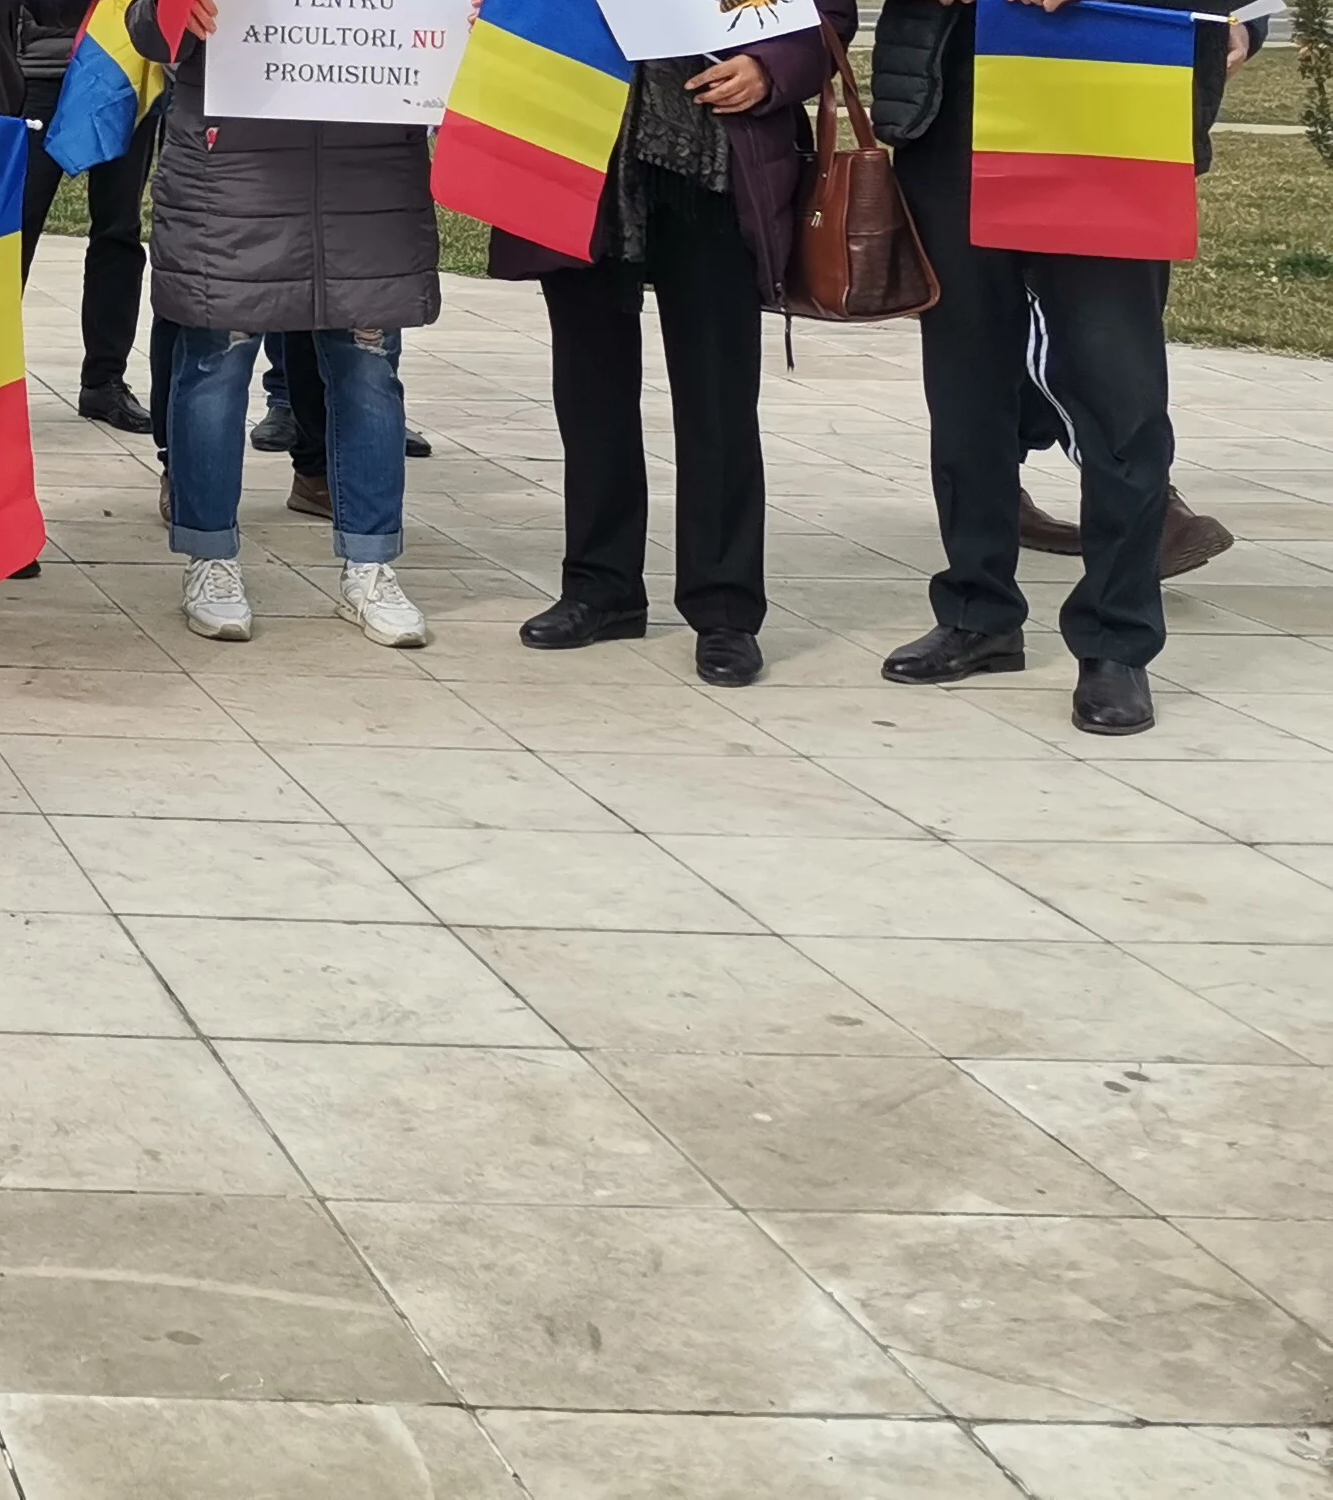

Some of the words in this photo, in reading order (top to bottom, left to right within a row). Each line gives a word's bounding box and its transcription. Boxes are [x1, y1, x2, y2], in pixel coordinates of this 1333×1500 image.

[242, 25, 403, 51] APICULTORI,
[410, 29, 447, 50] NU
[264, 62, 421, 86] PROMISIUNI!
